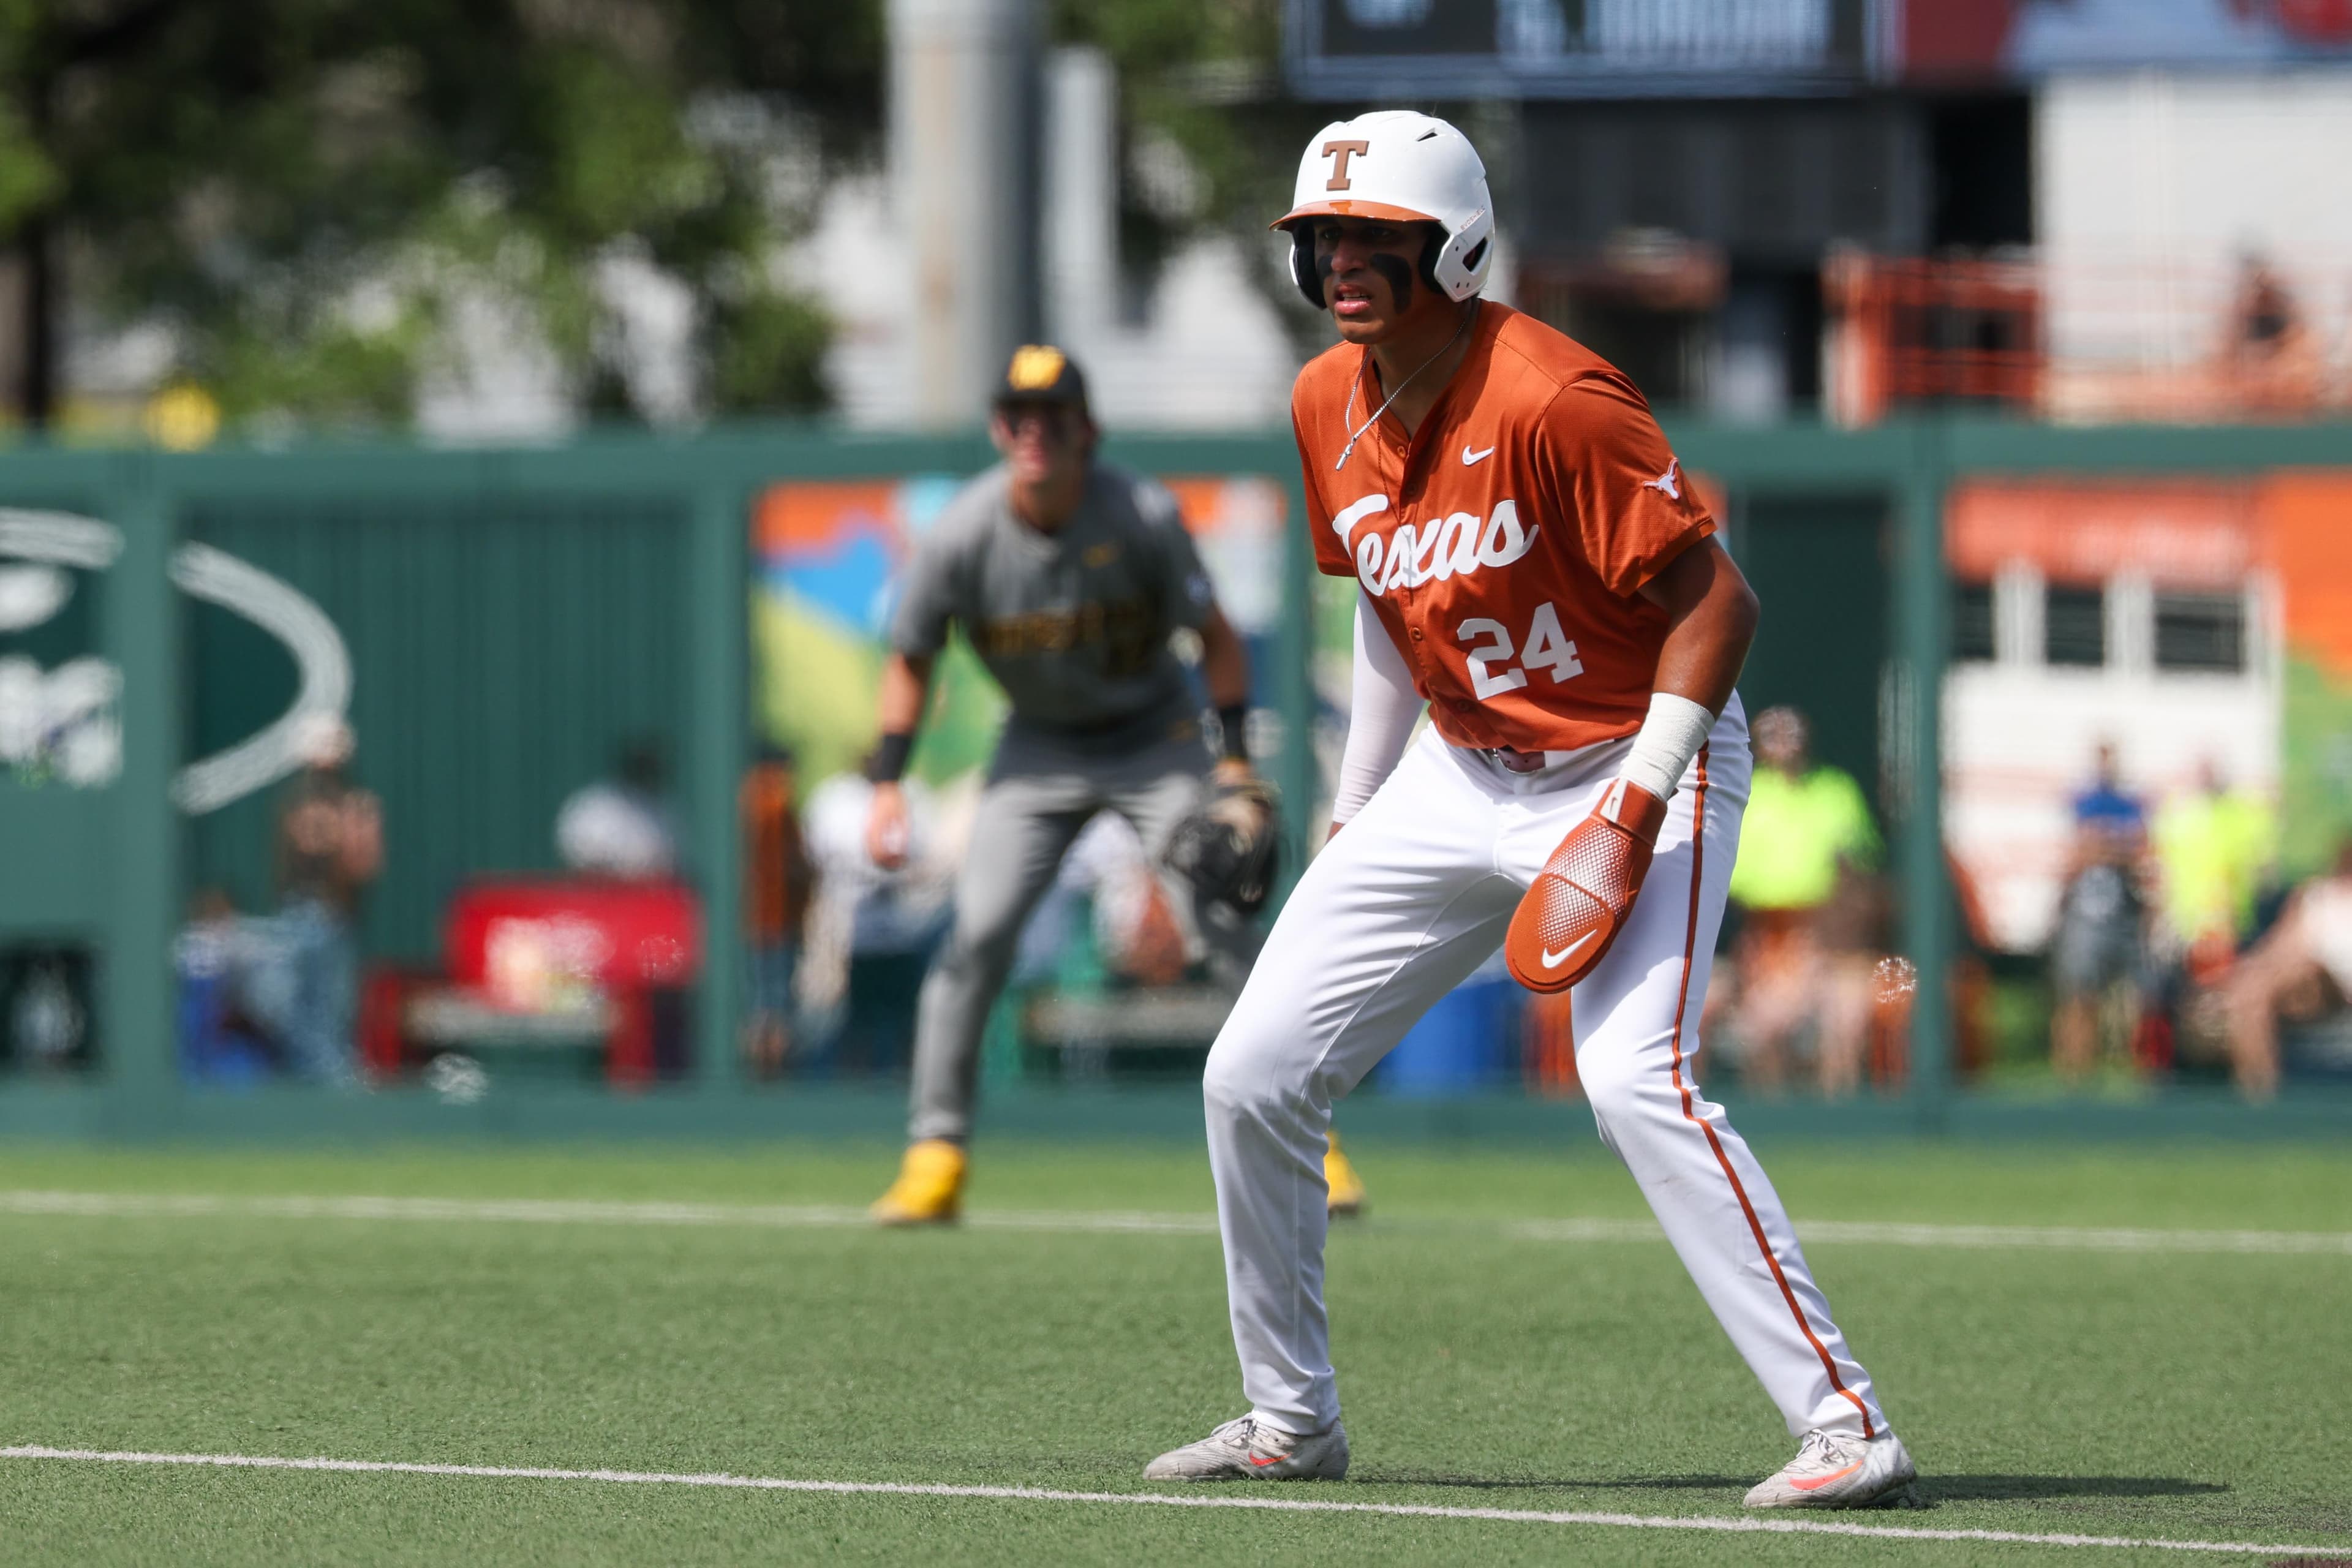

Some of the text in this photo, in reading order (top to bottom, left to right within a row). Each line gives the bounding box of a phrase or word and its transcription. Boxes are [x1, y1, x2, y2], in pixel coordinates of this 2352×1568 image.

[1322, 140, 1370, 191] T
[1332, 494, 1539, 596] Texas
[1457, 601, 1584, 701] 24
